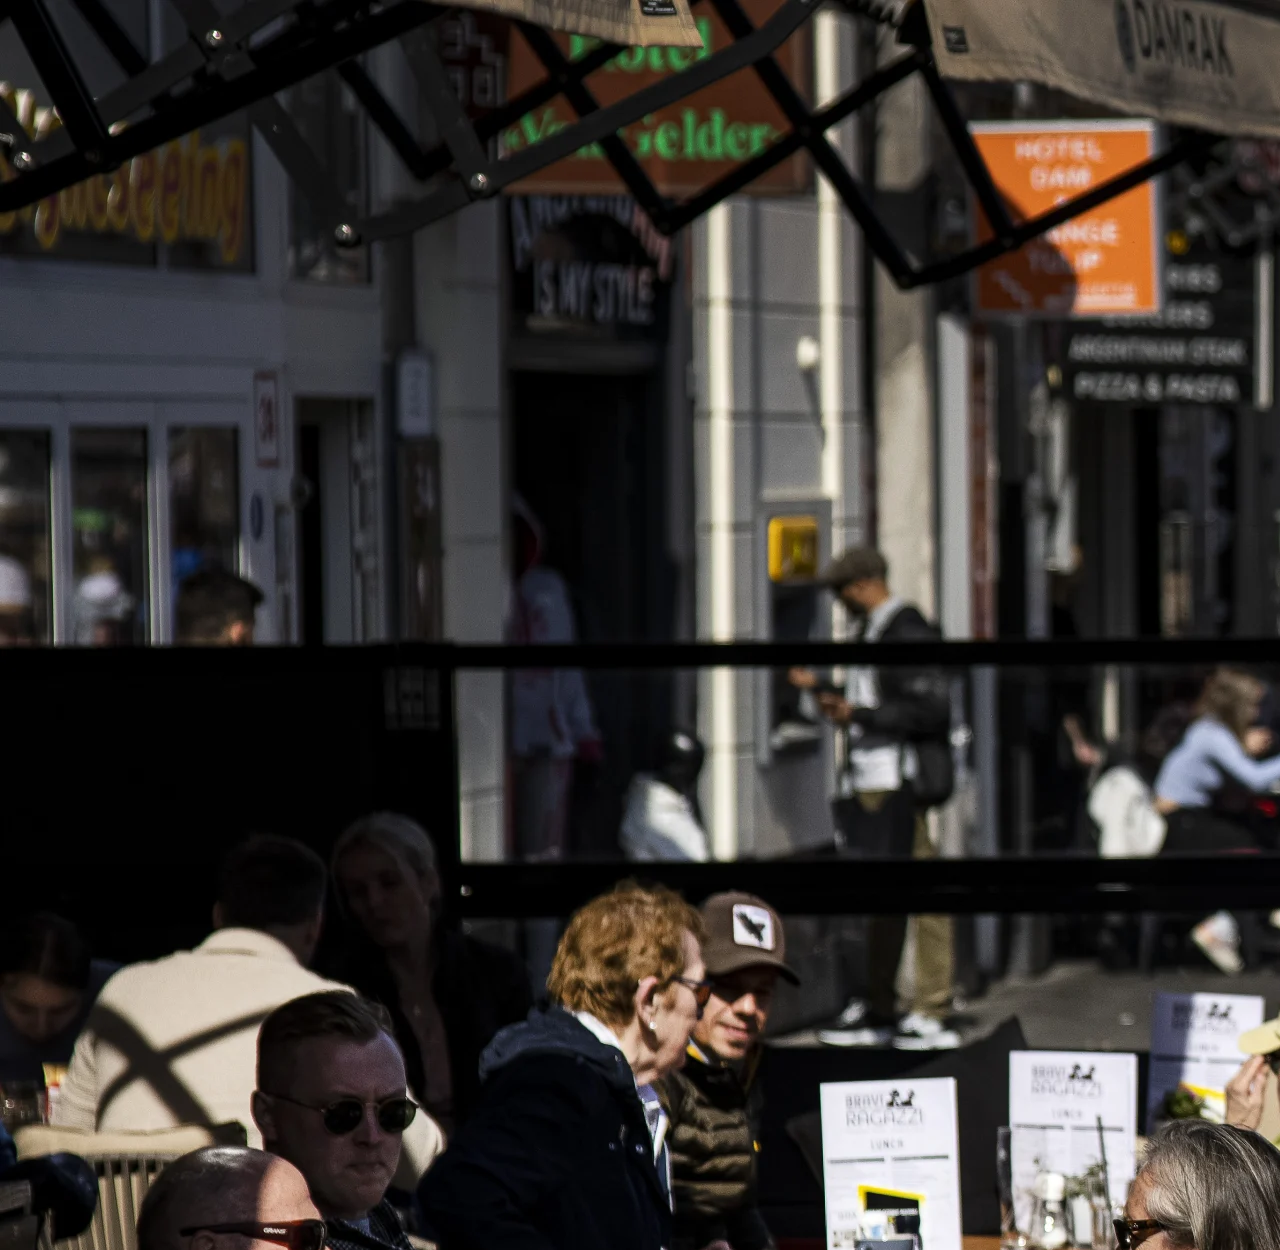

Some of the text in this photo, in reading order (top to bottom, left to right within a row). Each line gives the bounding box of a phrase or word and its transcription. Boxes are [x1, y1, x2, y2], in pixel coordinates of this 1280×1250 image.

[1131, 0, 1235, 78] DAMRAK
[1014, 137, 1103, 163] HOTEL
[1029, 165, 1093, 191] DAM
[845, 1094, 884, 1108] BRAVI
[845, 1107, 924, 1127] RAGAZZI
[870, 1138, 904, 1150] LUNCH
